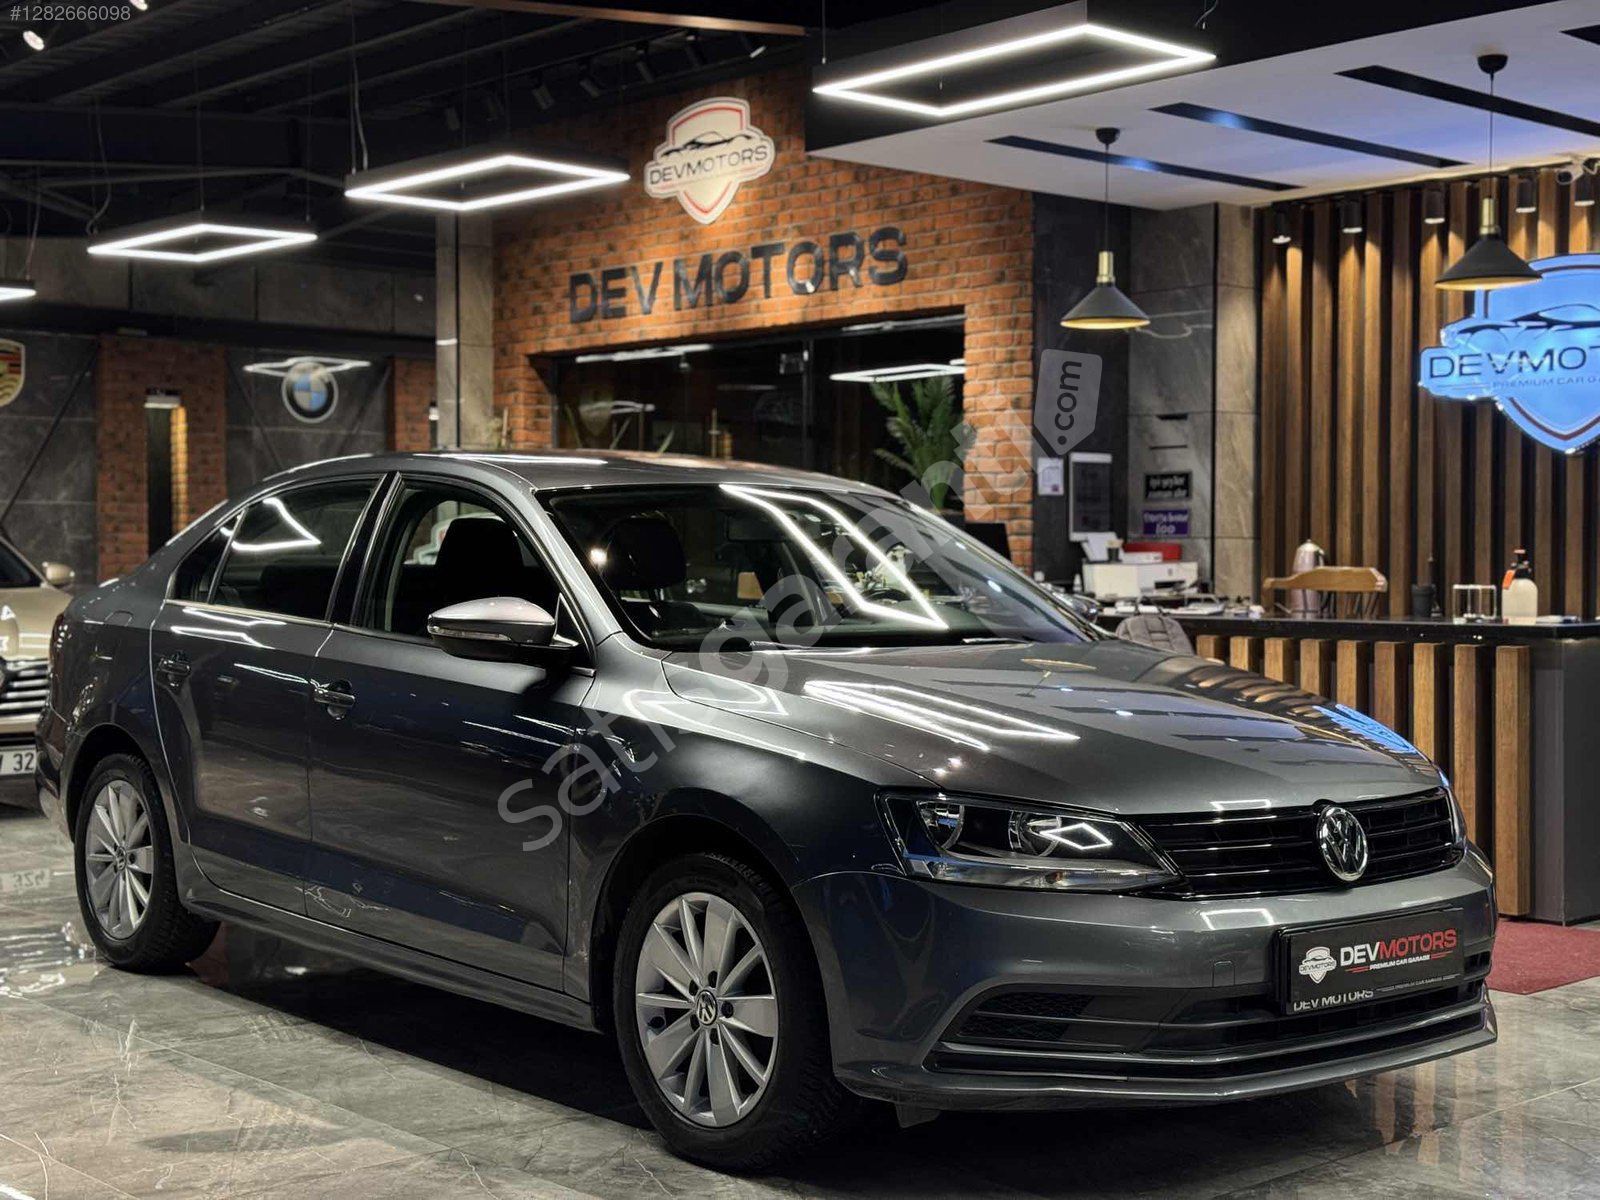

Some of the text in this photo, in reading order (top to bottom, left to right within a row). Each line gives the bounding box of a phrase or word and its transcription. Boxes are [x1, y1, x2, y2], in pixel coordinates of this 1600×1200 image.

[649, 145, 768, 185] DEVMOTORS
[569, 226, 908, 324] DEV MOTORS
[1557, 377, 1584, 385] CAR
[1340, 929, 1457, 967] DEVMOTORS
